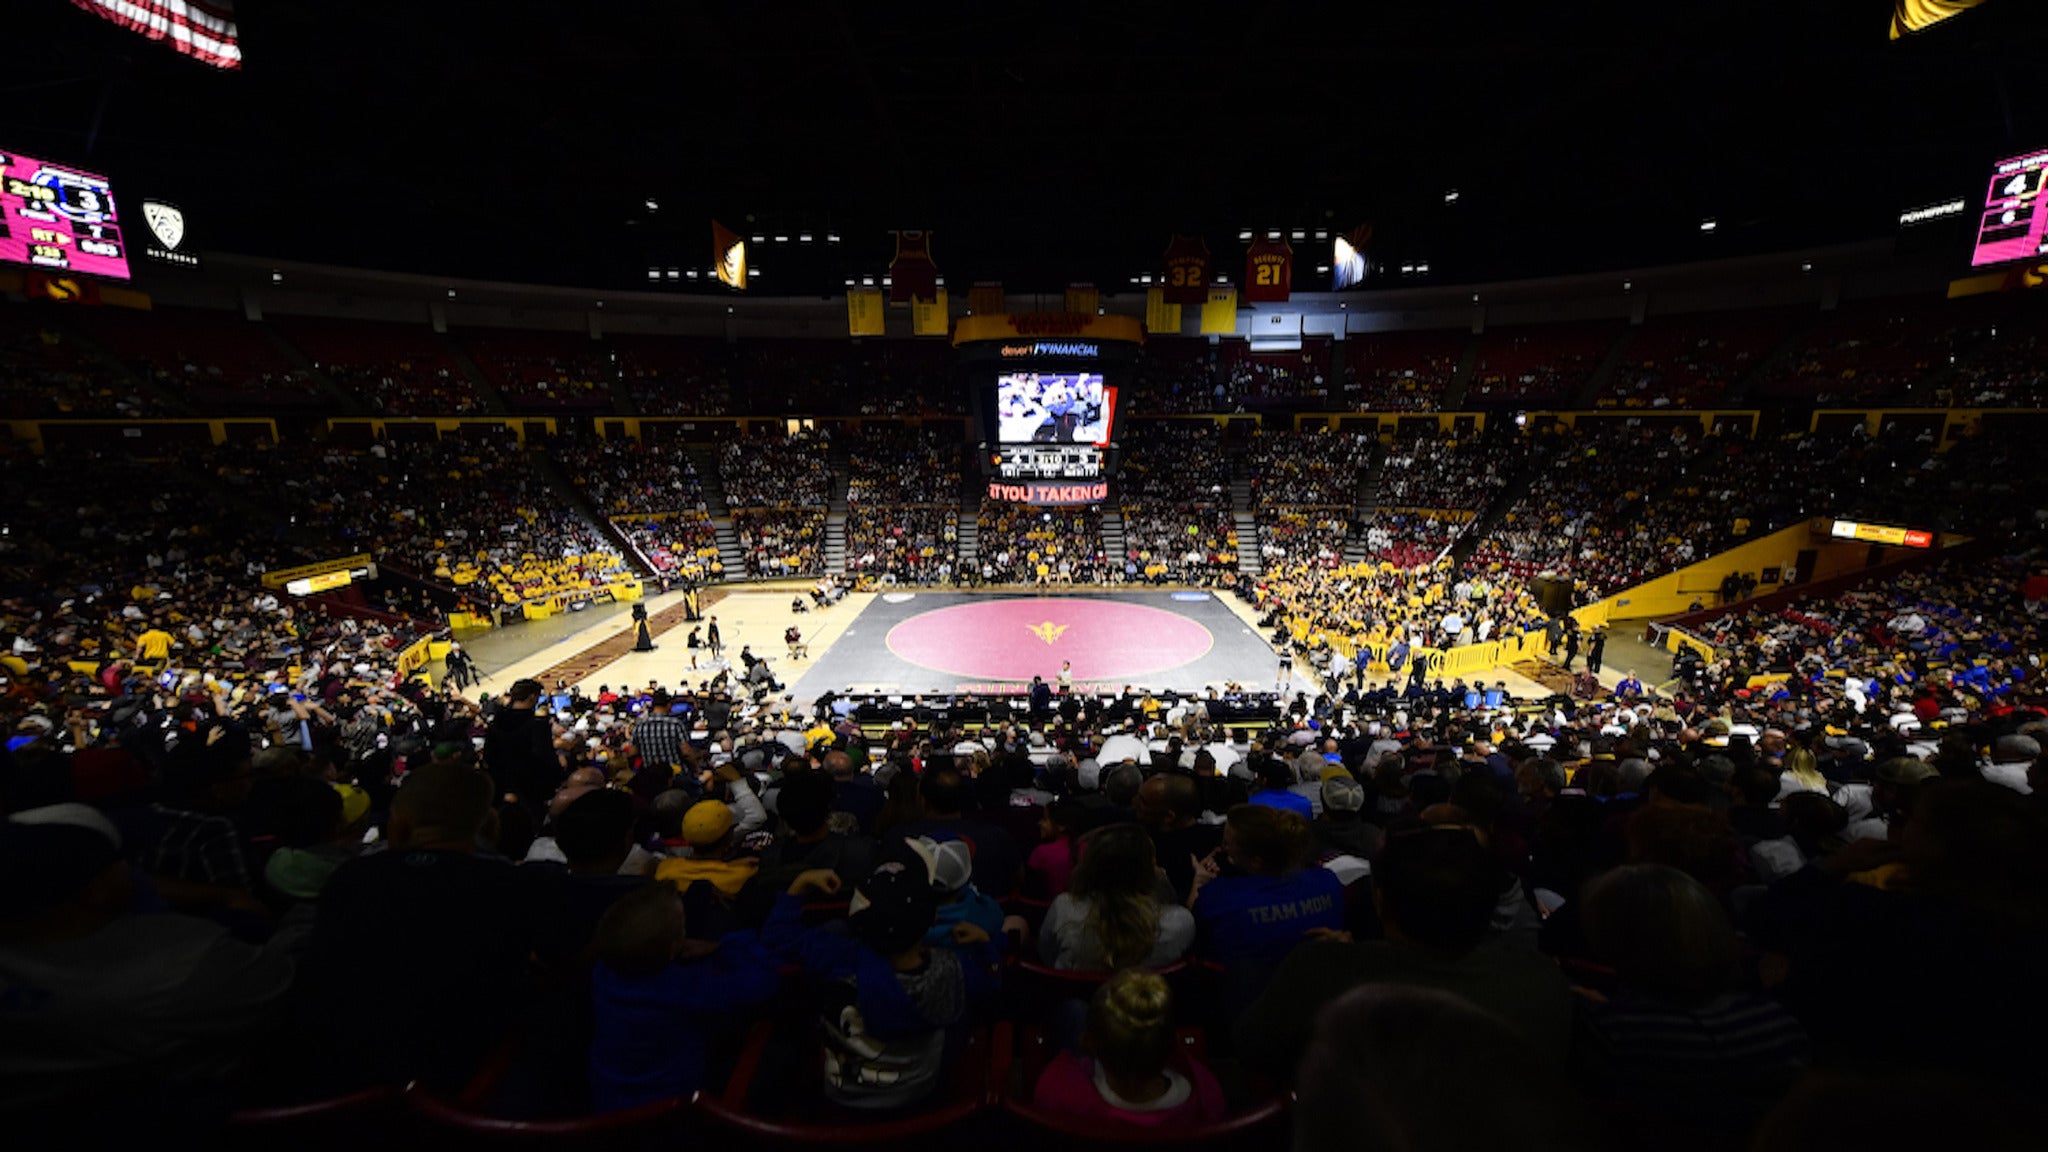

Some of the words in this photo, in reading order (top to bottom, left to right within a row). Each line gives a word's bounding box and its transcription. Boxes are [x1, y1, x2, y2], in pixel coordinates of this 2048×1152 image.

[2004, 175, 2027, 195] 4
[79, 191, 100, 211] 3
[1899, 200, 1966, 224] POWERADE
[1171, 266, 1202, 287] 32
[1256, 264, 1281, 286] 21
[1001, 485, 1034, 502] YOU
[1036, 486, 1091, 502] TAKEN
[1248, 901, 1299, 924] TEAM
[1299, 895, 1333, 917] MOM
